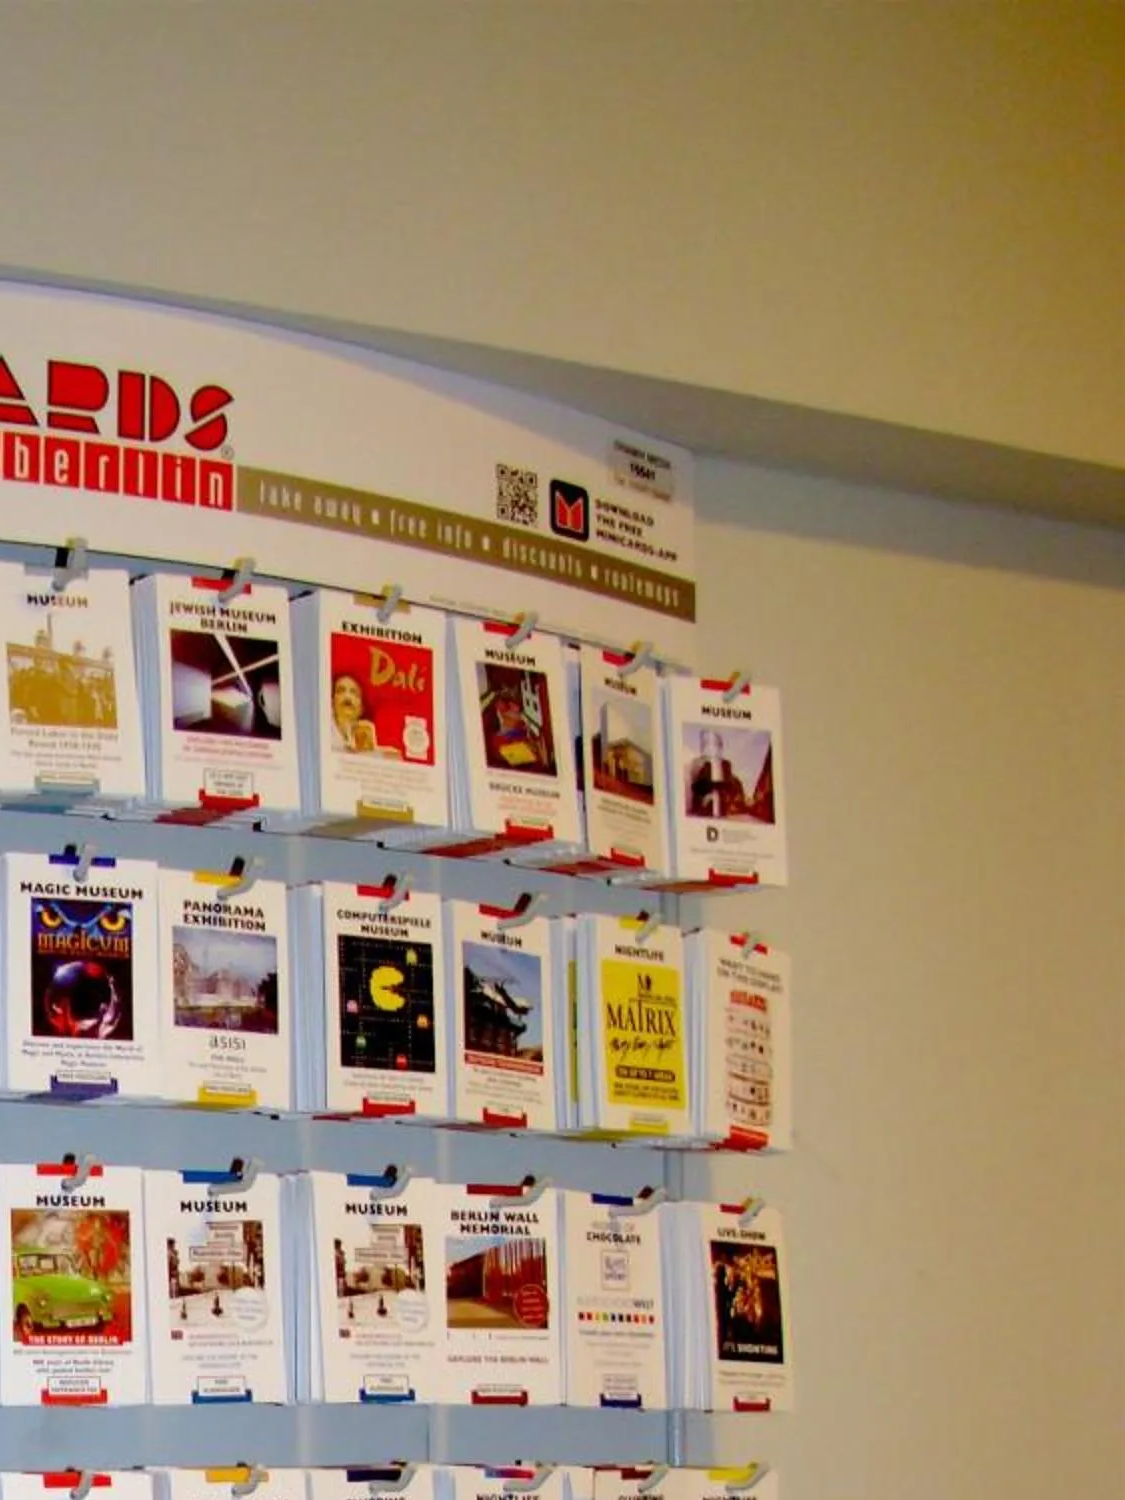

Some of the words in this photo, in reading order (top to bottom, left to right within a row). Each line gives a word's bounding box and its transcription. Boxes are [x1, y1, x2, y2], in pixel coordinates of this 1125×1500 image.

[26, 594, 89, 608] MUSEUM
[169, 602, 216, 619] JEWISH
[219, 607, 277, 625] MUSEUM
[200, 619, 248, 633] BERLIN
[341, 621, 423, 645] EXHIBITION
[484, 649, 537, 667] MUSEUM
[603, 677, 638, 696] MUSEUM
[700, 704, 753, 721] MUSEUM
[20, 882, 71, 896] MAGIC
[75, 885, 144, 900] MUSEUM
[183, 899, 265, 918] PANORAMA
[183, 913, 266, 932] EXHIBITION
[360, 925, 410, 939] MUSEUM
[36, 1195, 106, 1207] MUSEUM
[180, 1200, 248, 1213] MUSEUM
[345, 1203, 408, 1217] MUSEUM
[450, 1210, 499, 1223] BERLIN
[504, 1212, 540, 1224] WALL
[459, 1223, 531, 1236] MEMORIAL
